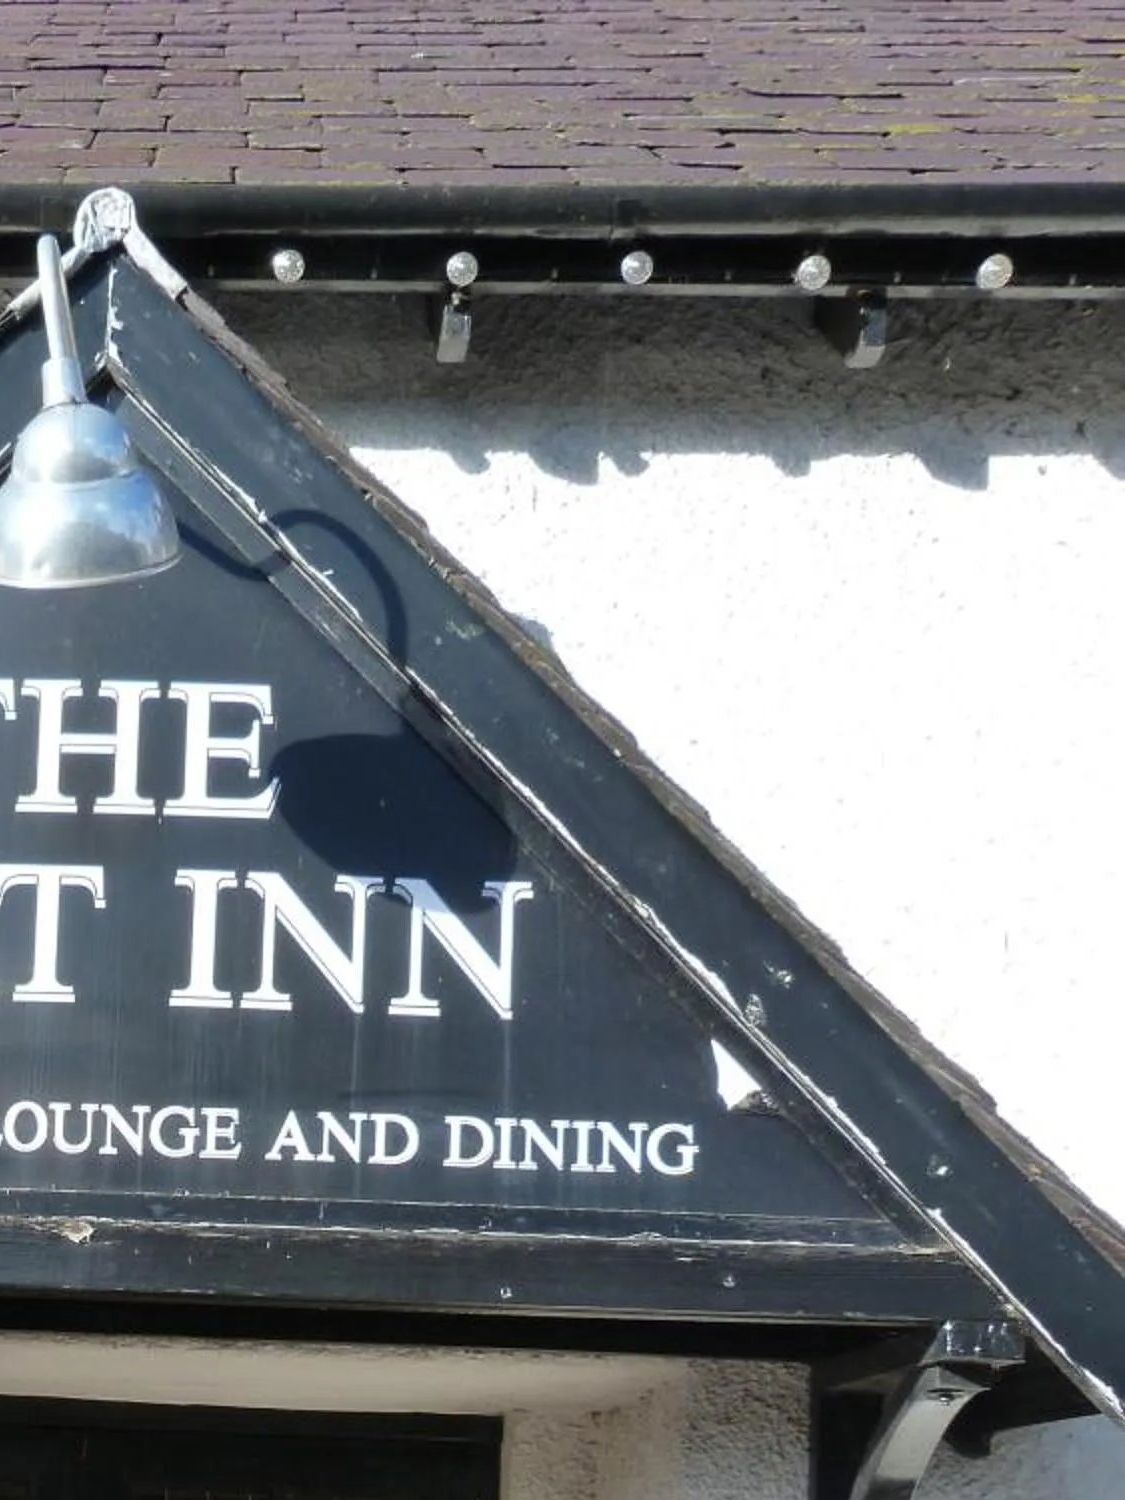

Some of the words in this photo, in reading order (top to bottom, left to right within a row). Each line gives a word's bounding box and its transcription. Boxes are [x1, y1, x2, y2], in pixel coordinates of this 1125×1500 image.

[169, 868, 534, 1020] INN
[265, 1110, 420, 1165] AND
[443, 1115, 699, 1176] DINING
